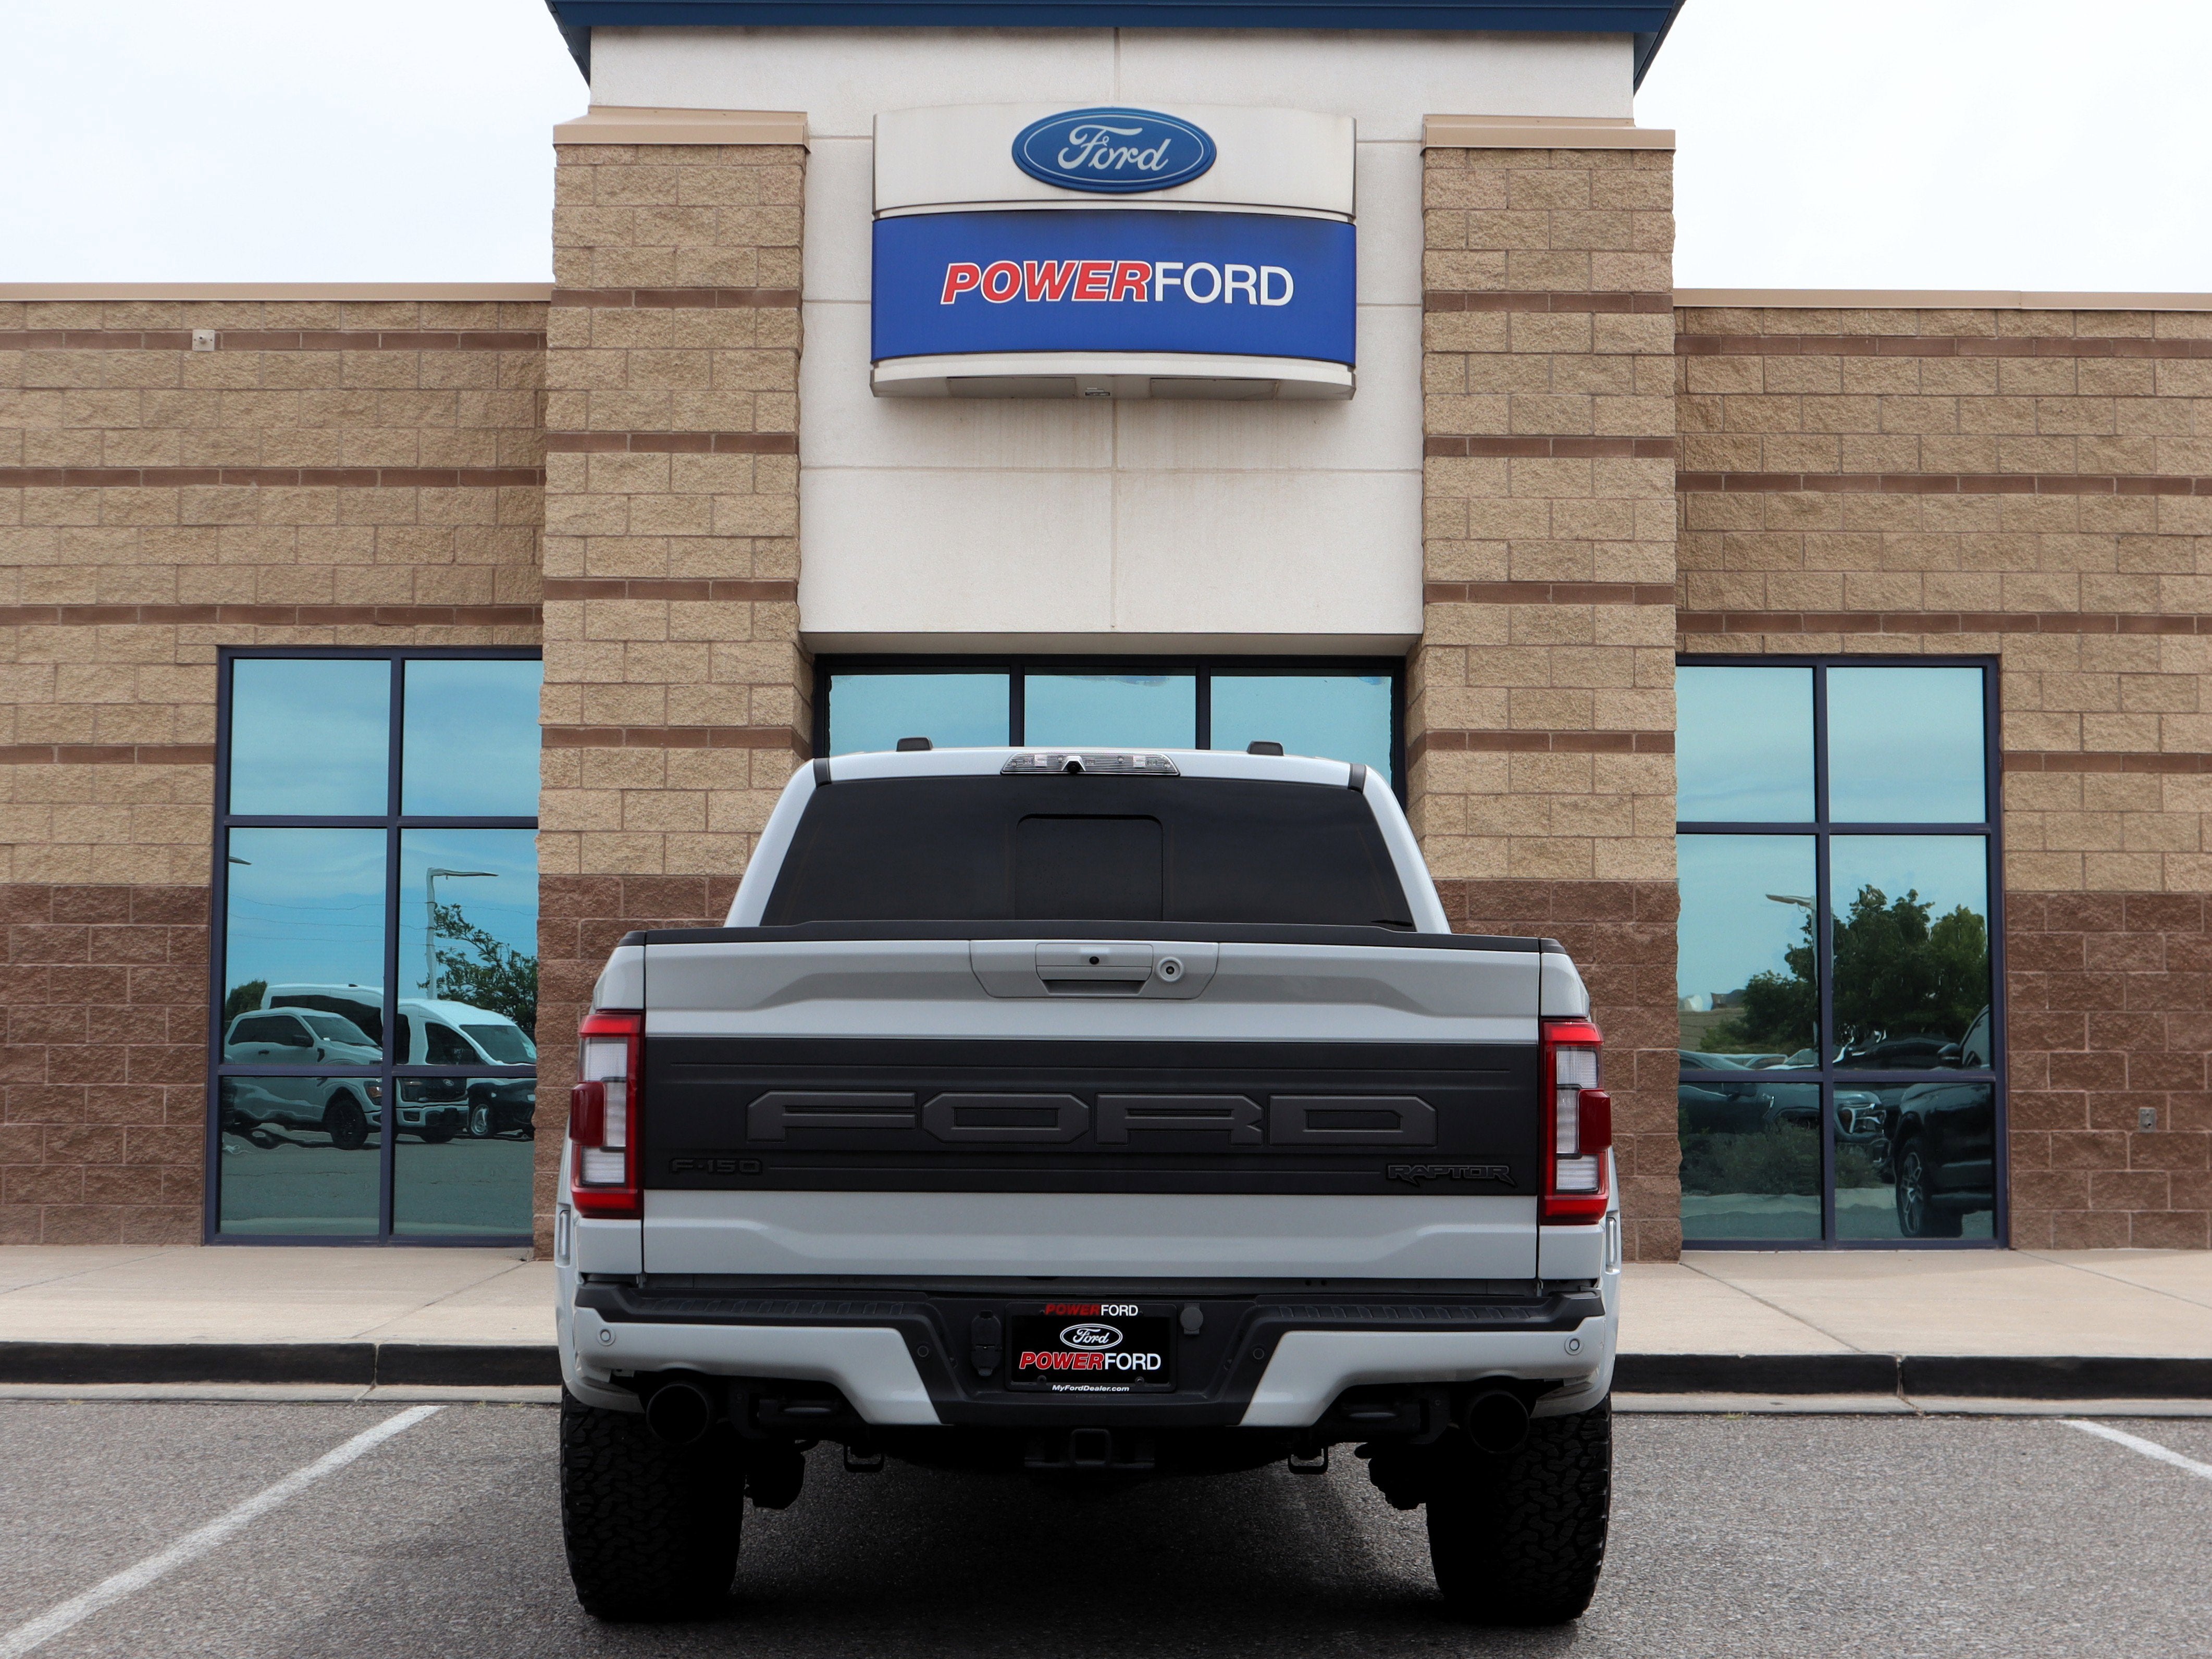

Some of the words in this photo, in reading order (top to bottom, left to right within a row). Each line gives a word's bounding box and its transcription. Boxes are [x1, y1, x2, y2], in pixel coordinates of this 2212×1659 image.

[1058, 124, 1172, 171] Ford
[746, 1089, 1437, 1146] FORD
[671, 1158, 761, 1173] F-150
[1388, 1165, 1517, 1188] RAPTOR
[1072, 1328, 1109, 1344] Ford
